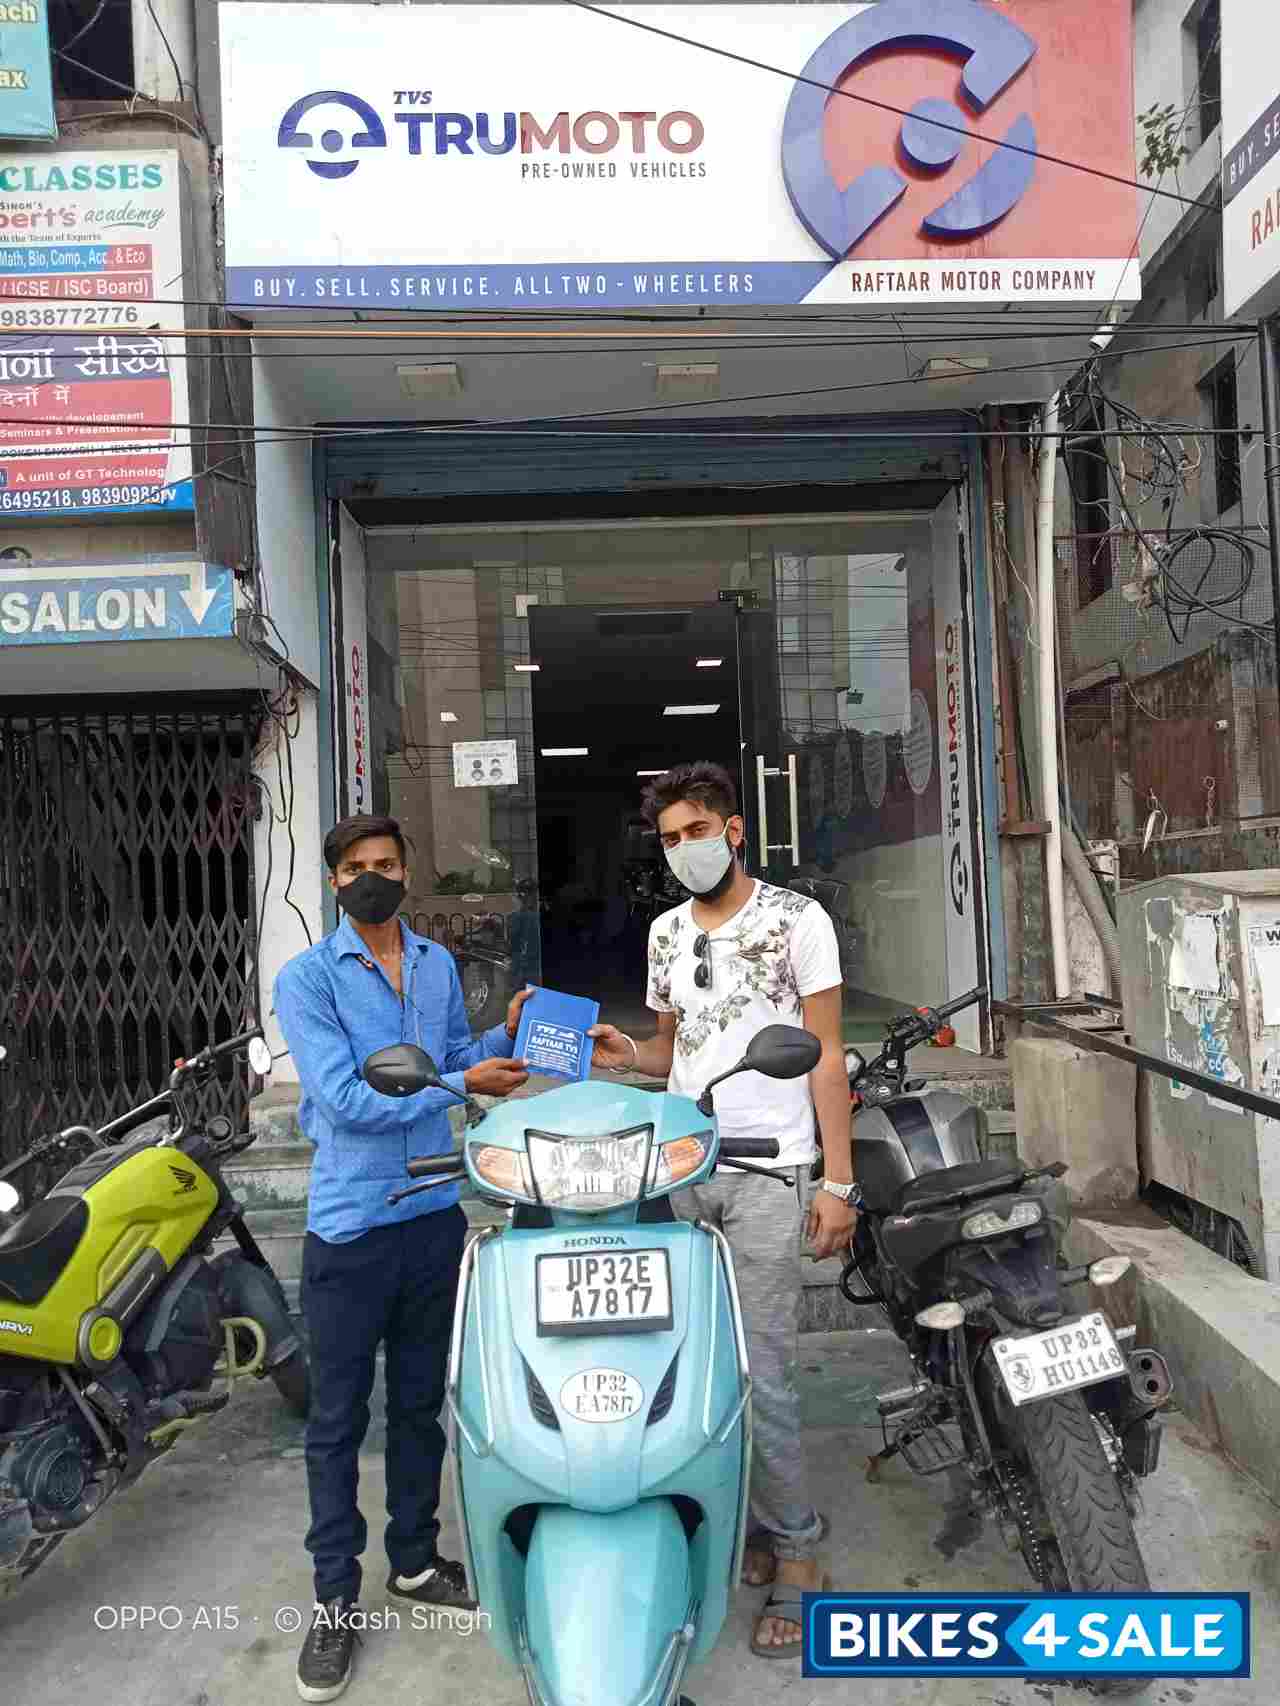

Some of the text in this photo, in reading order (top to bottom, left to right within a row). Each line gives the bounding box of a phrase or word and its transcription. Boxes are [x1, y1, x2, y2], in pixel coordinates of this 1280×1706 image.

[393, 90, 432, 105] TVS
[395, 110, 705, 154] TRUMOTO
[0, 164, 163, 192] CLASSES
[521, 162, 707, 179] PRE-OWNED VEHICLES
[84, 200, 166, 230] academy
[96, 277, 148, 297] Board)
[852, 270, 1096, 292] RAFTAAR MOTOR COMPANY
[16, 472, 25, 483] A
[59, 470, 71, 481] of
[1, 588, 167, 634] SALON
[564, 1236, 627, 1248] HONDA
[567, 1255, 651, 1287] UP32E
[571, 1286, 653, 1319] A7817
[1039, 1327, 1101, 1358] UP32
[1043, 1347, 1122, 1386] HU1148
